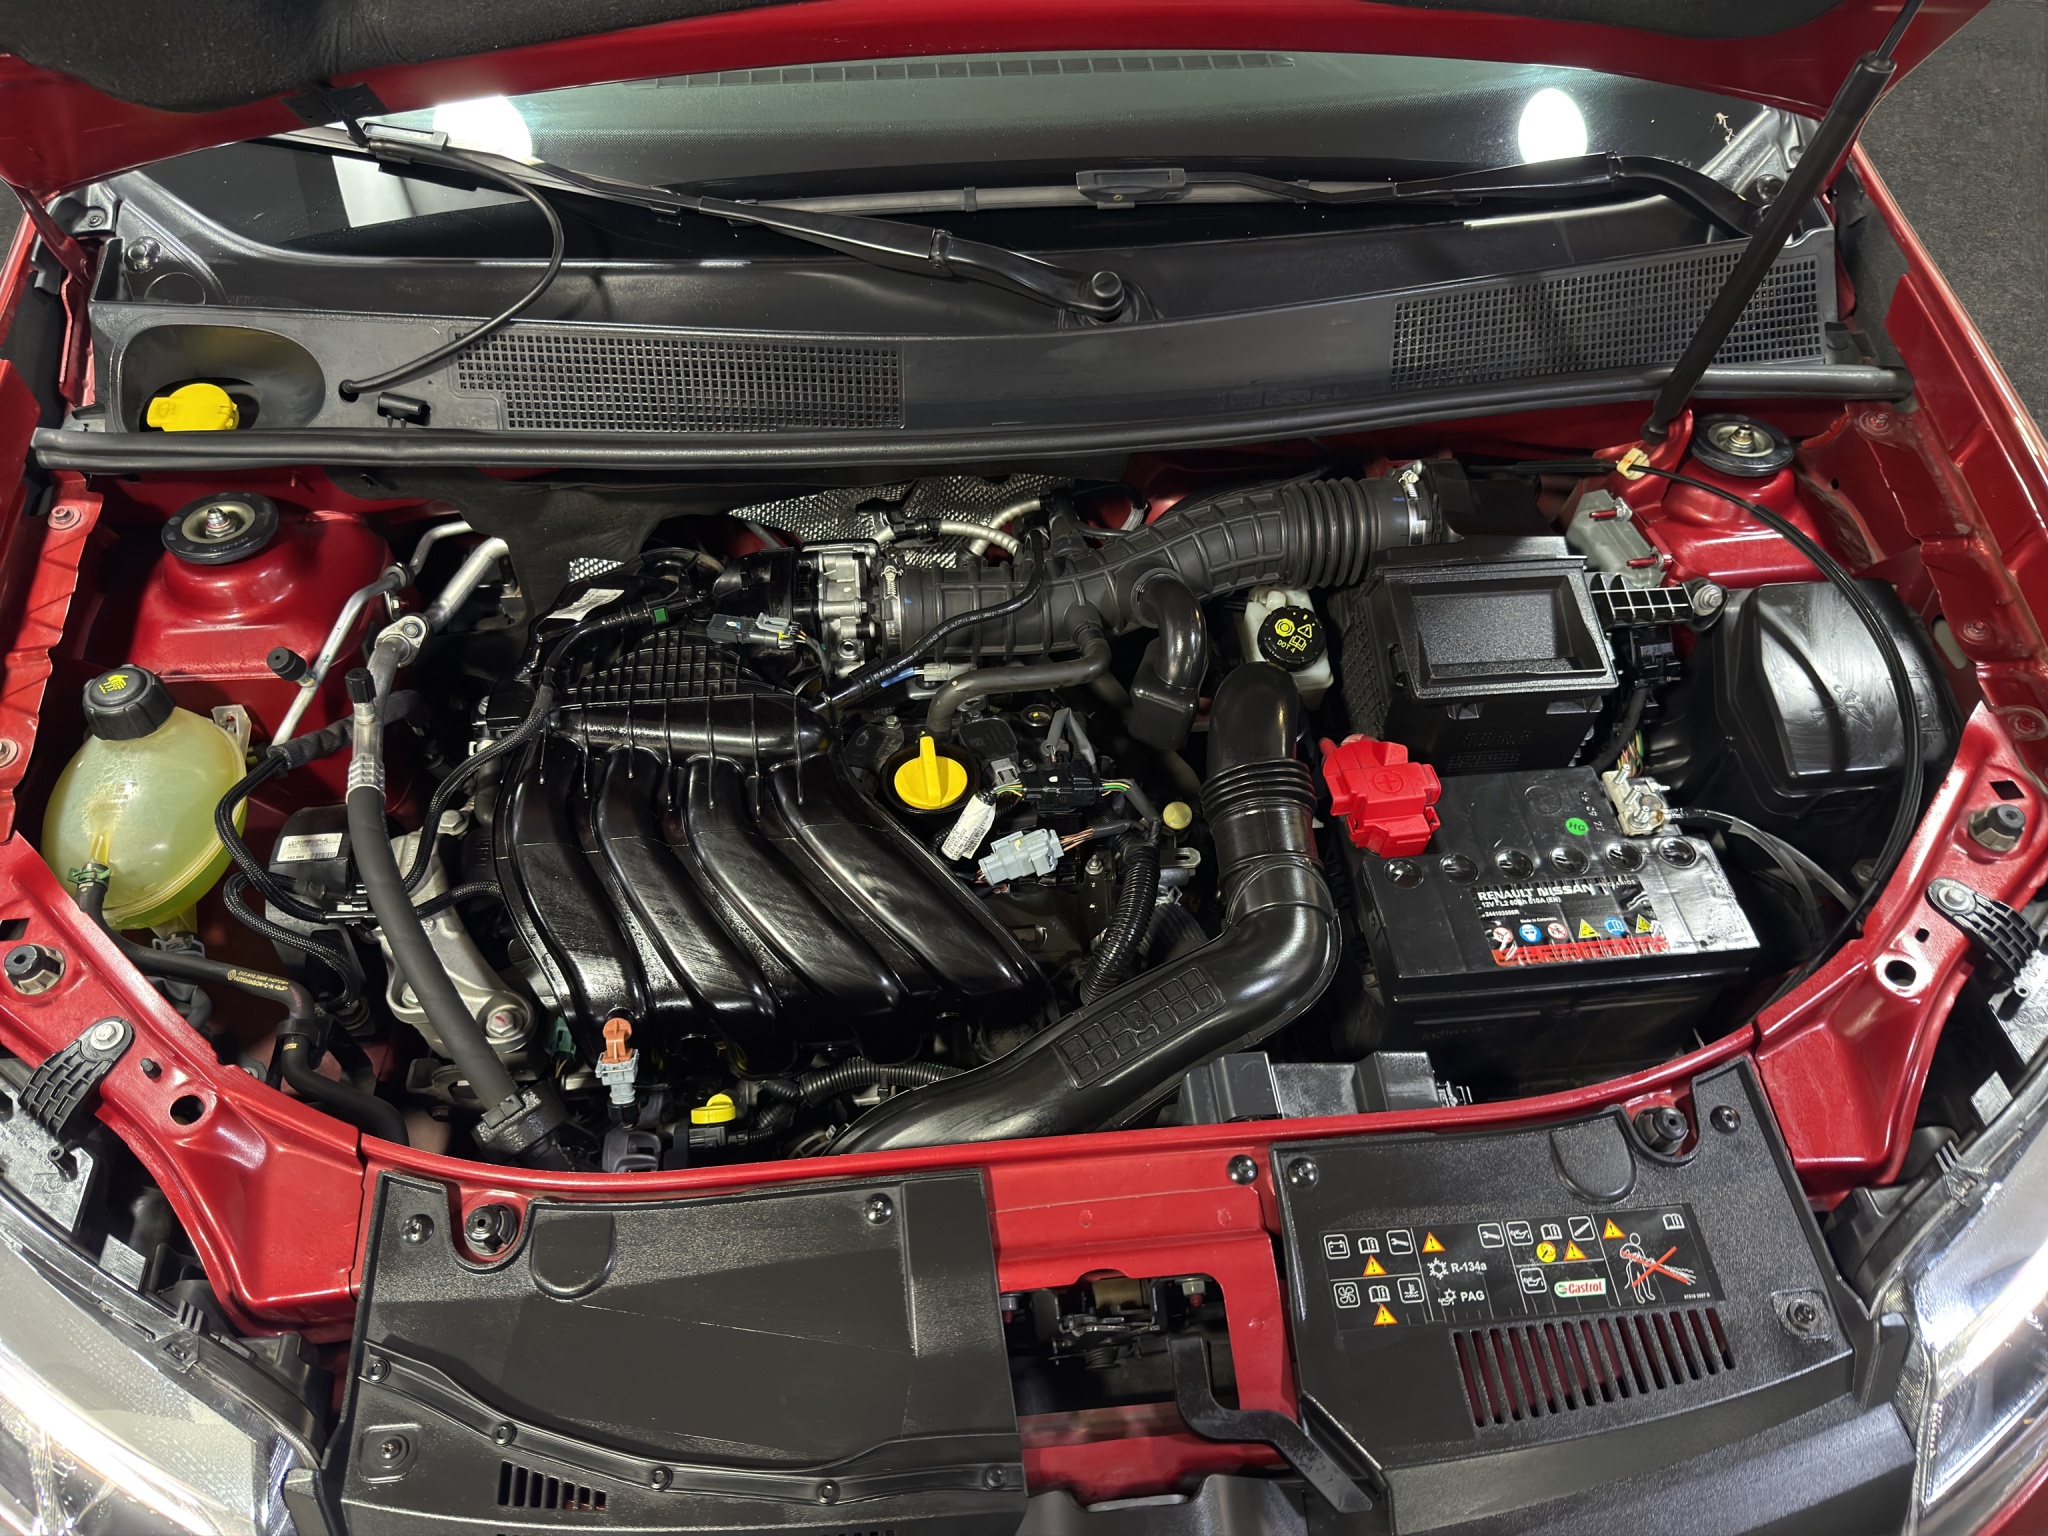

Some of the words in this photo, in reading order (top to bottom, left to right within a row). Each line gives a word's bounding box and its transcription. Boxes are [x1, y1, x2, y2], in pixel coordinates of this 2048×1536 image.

[1277, 639, 1291, 649] DOT
[1569, 822, 1586, 832] HG
[1477, 888, 1534, 901] RENAULT
[1537, 883, 1596, 897] NISSAN
[1481, 899, 1495, 908] 12V
[1546, 895, 1561, 904] (EN)
[1451, 1261, 1487, 1273] R-134a
[1568, 1281, 1603, 1294] Castrol
[1460, 1290, 1485, 1302] PAG
